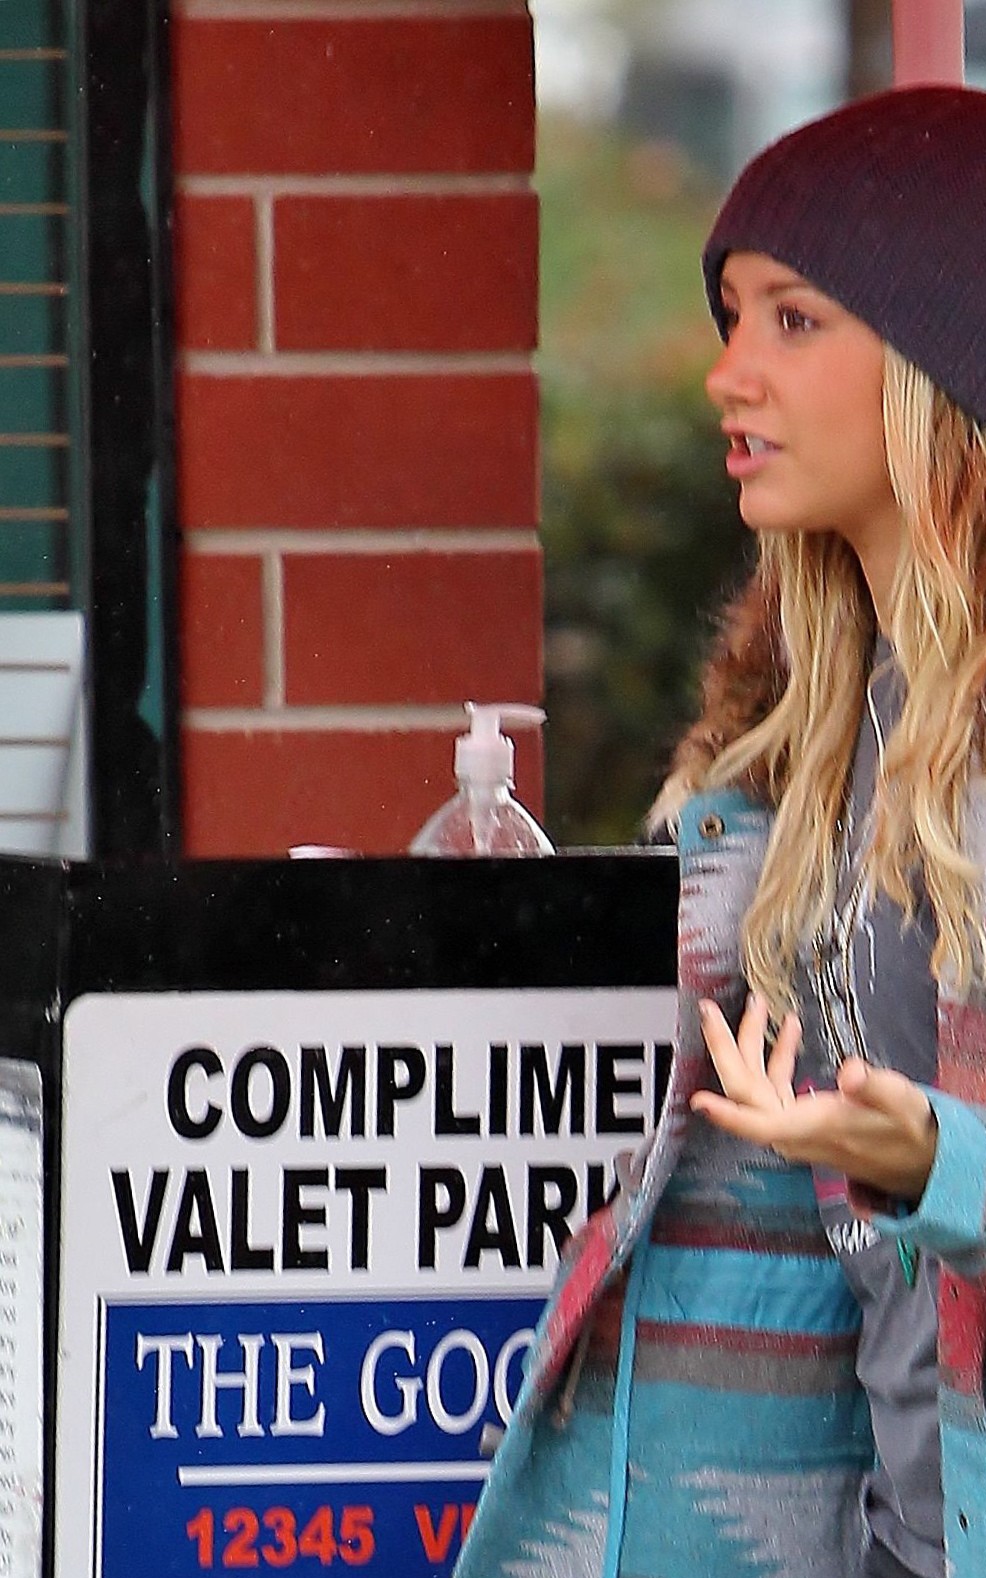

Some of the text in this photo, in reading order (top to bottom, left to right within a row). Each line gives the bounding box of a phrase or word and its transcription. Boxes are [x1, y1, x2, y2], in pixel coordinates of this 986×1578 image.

[111, 1168, 387, 1275] VALET
[136, 1330, 326, 1440] THE
[187, 1505, 376, 1569] 12345
